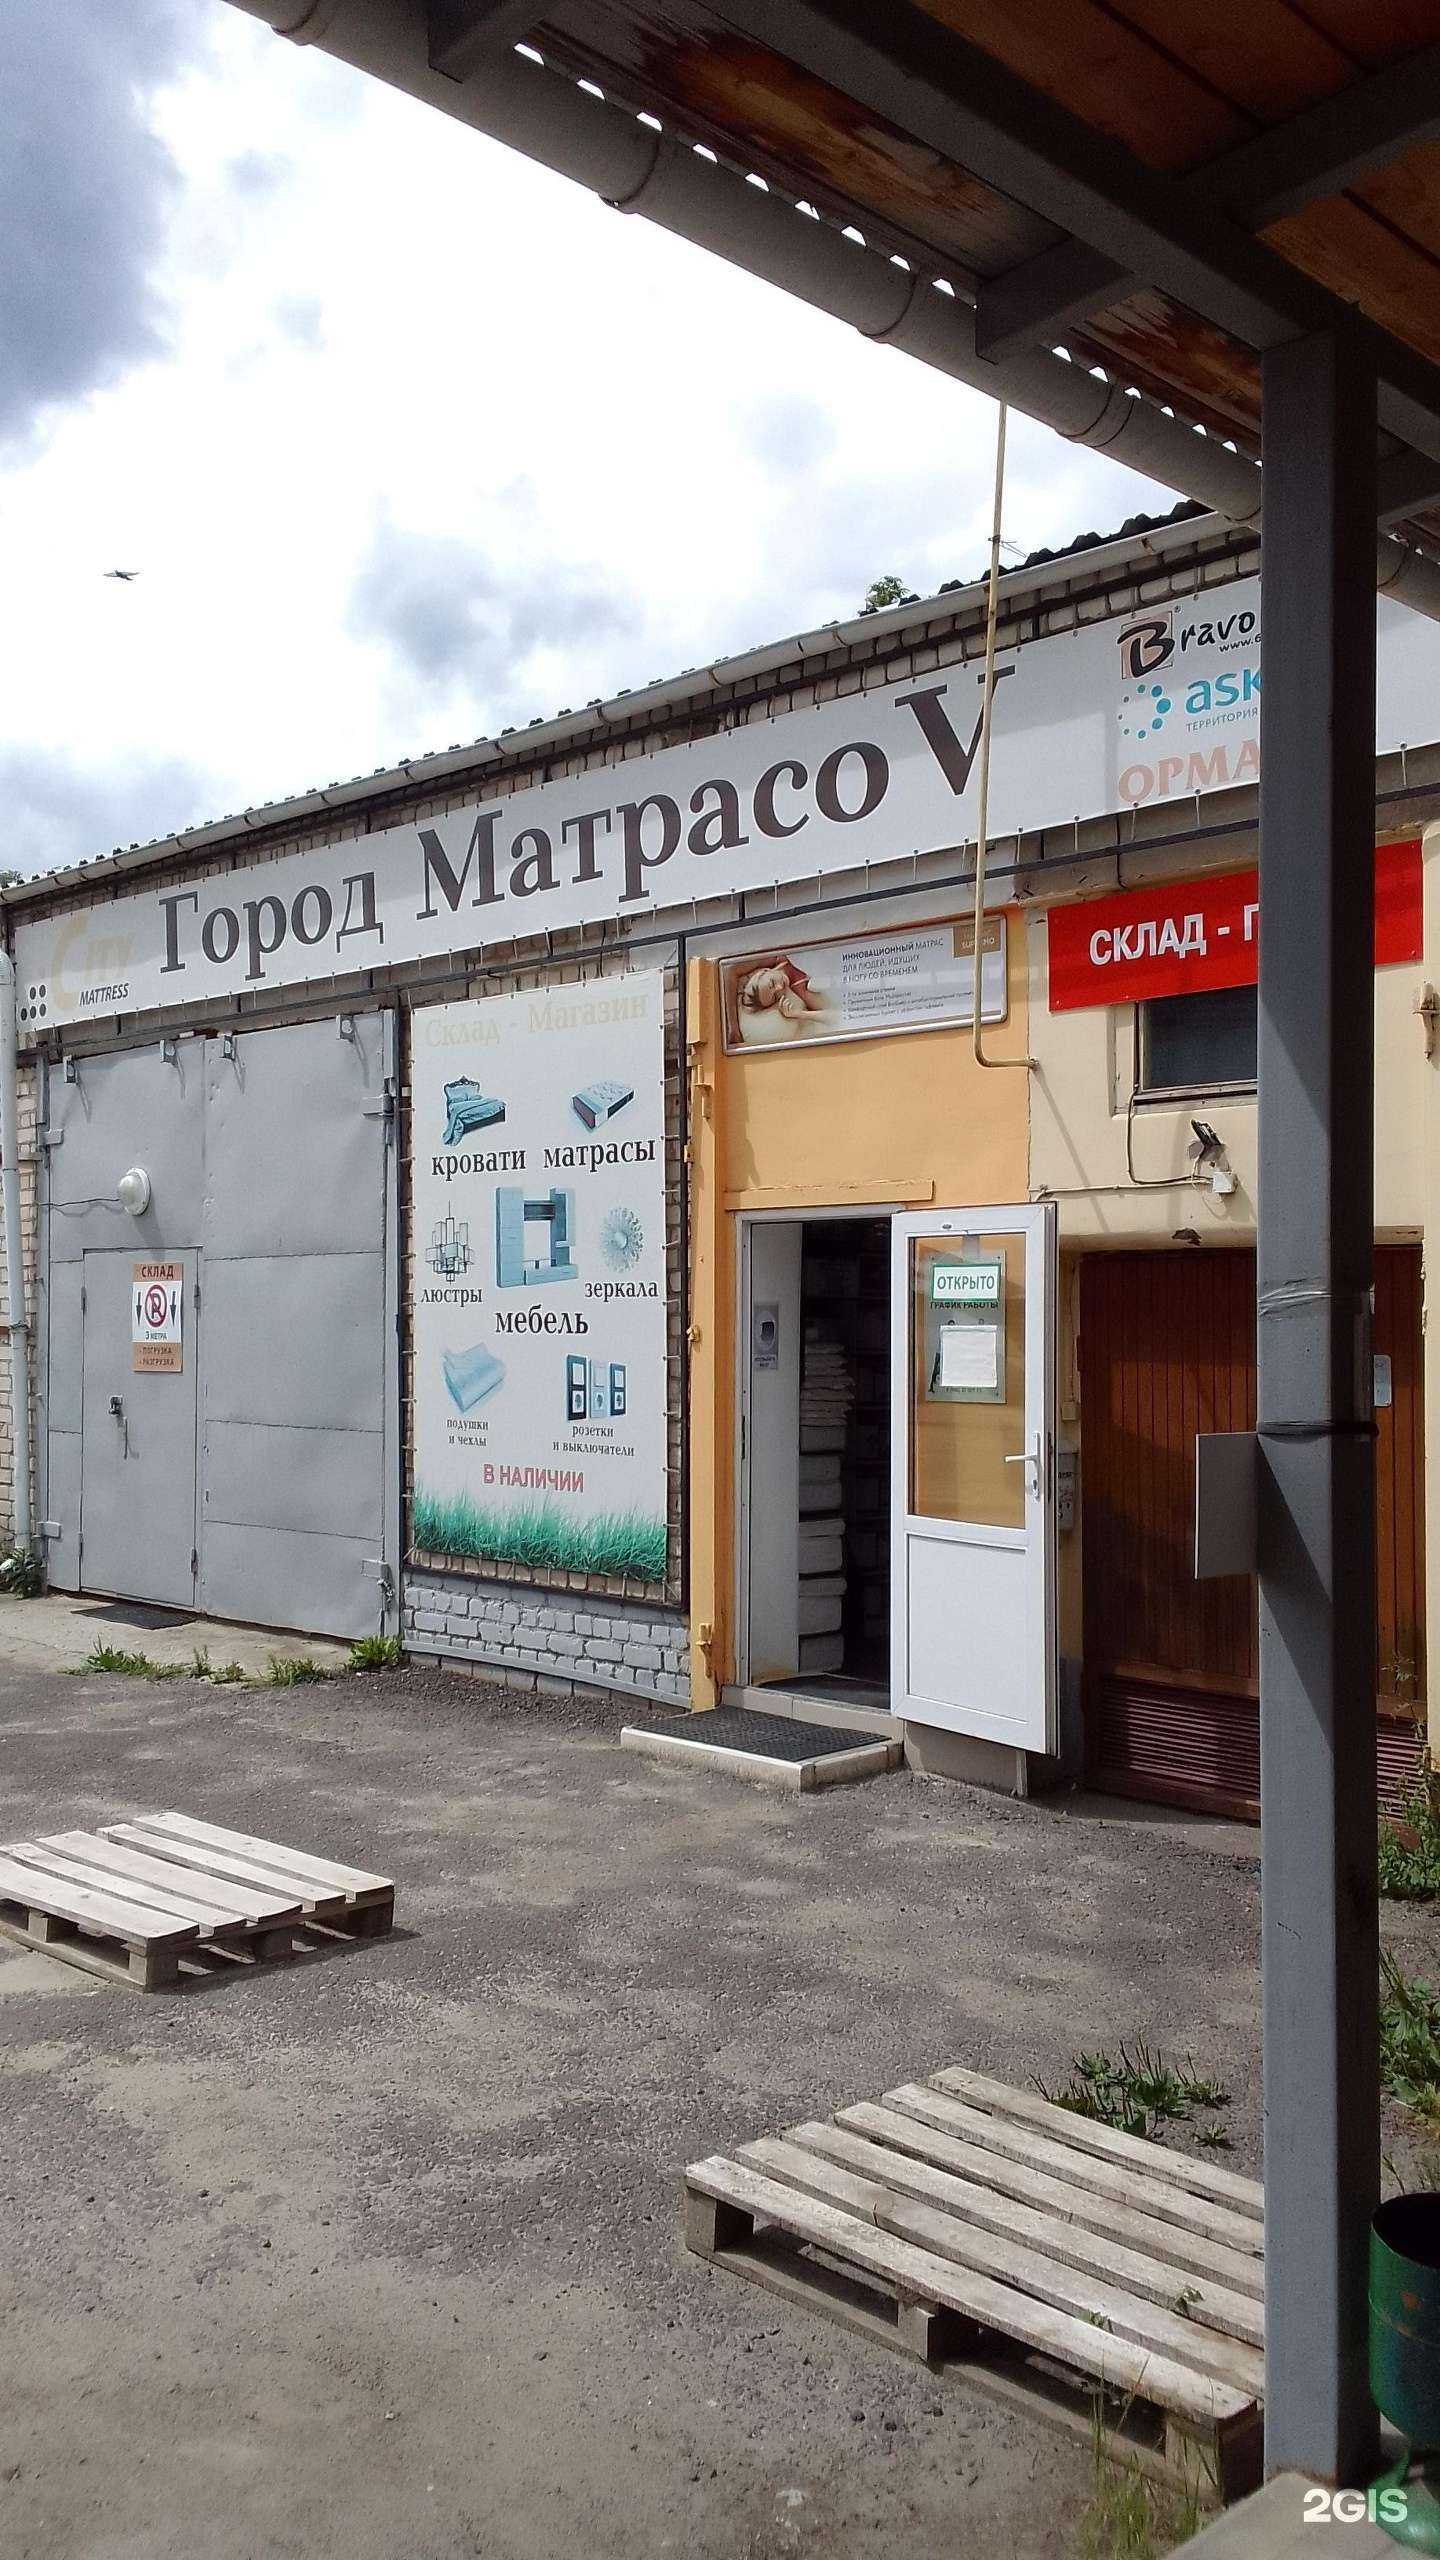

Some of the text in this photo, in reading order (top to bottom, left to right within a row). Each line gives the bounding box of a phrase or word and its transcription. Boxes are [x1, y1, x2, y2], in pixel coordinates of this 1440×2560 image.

[1117, 611, 1256, 678] Bravo
[1186, 707, 1258, 733] ТЕРРИТОРИЯ
[159, 872, 384, 980] Город
[1089, 913, 1207, 966] СКЛАД
[842, 943, 914, 961] ИННОВАЦИОННЫЙ
[79, 982, 129, 1006] MATTRESS
[425, 1018, 501, 1048] Склад
[528, 994, 648, 1033] Магазин
[431, 1139, 656, 1181] кровати матрасы
[141, 1266, 174, 1279] СКЛАД
[937, 1275, 995, 1290] ОТКРЫТО
[421, 1287, 482, 1307] люстры
[584, 1281, 658, 1302] зеркала
[495, 1304, 589, 1335] мебель
[447, 1418, 489, 1431] подушки
[572, 1425, 614, 1438] розетки
[457, 1436, 487, 1447] чехлы
[562, 1442, 635, 1457] выключатели
[483, 1464, 584, 1493] В НАЛИЧИИ
